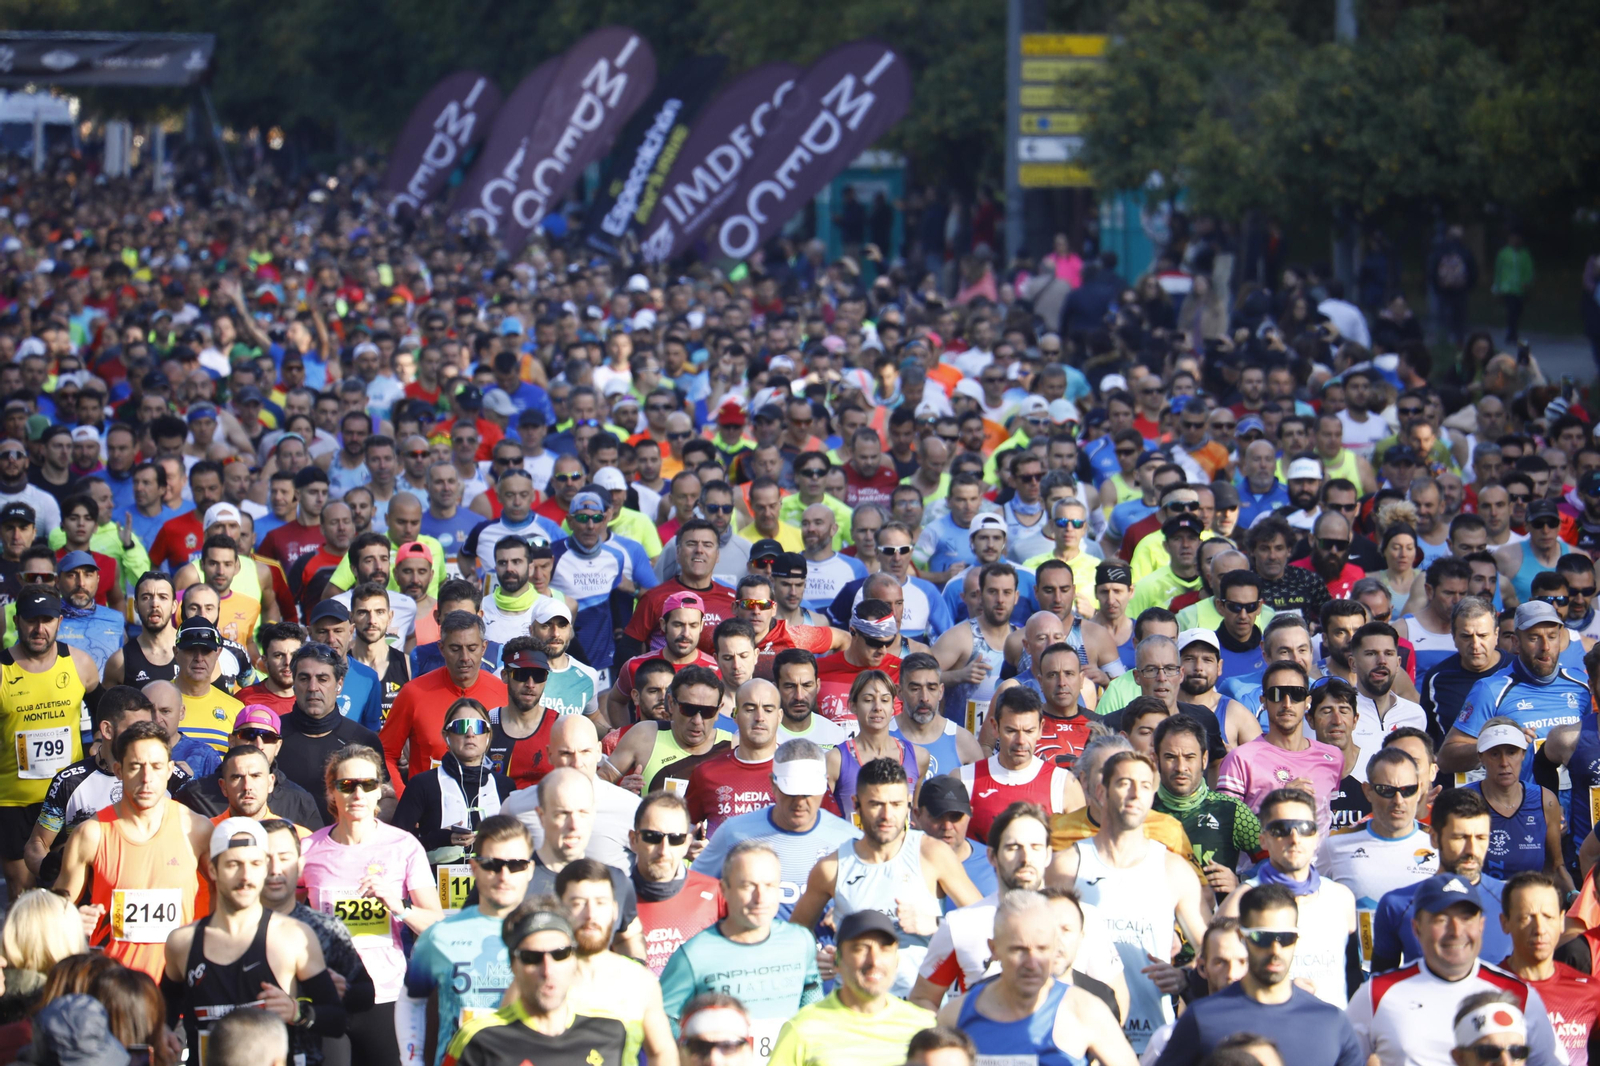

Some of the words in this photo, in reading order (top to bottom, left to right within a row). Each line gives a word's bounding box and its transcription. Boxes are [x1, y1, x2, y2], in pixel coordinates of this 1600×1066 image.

[512, 34, 640, 229] IMDECO
[386, 76, 487, 218] IMDEC
[719, 50, 896, 259] IMDECO
[574, 578, 608, 586] PALMERA
[804, 581, 834, 590] LMERA
[702, 614, 722, 622] EDIA
[17, 704, 34, 713] CLUB
[35, 700, 71, 710] ATLETISMO
[538, 697, 564, 709] EDIA
[554, 704, 582, 715] ATÓN
[24, 710, 66, 722] MONTILLA
[33, 740, 64, 758] 799
[734, 792, 770, 802] MEDIA
[718, 803, 732, 814] 36
[734, 802, 776, 814] MARA
[125, 903, 176, 922] 2140
[334, 900, 386, 920] 5283
[452, 962, 472, 994] 5
[1556, 1018, 1586, 1036] ATÓN
